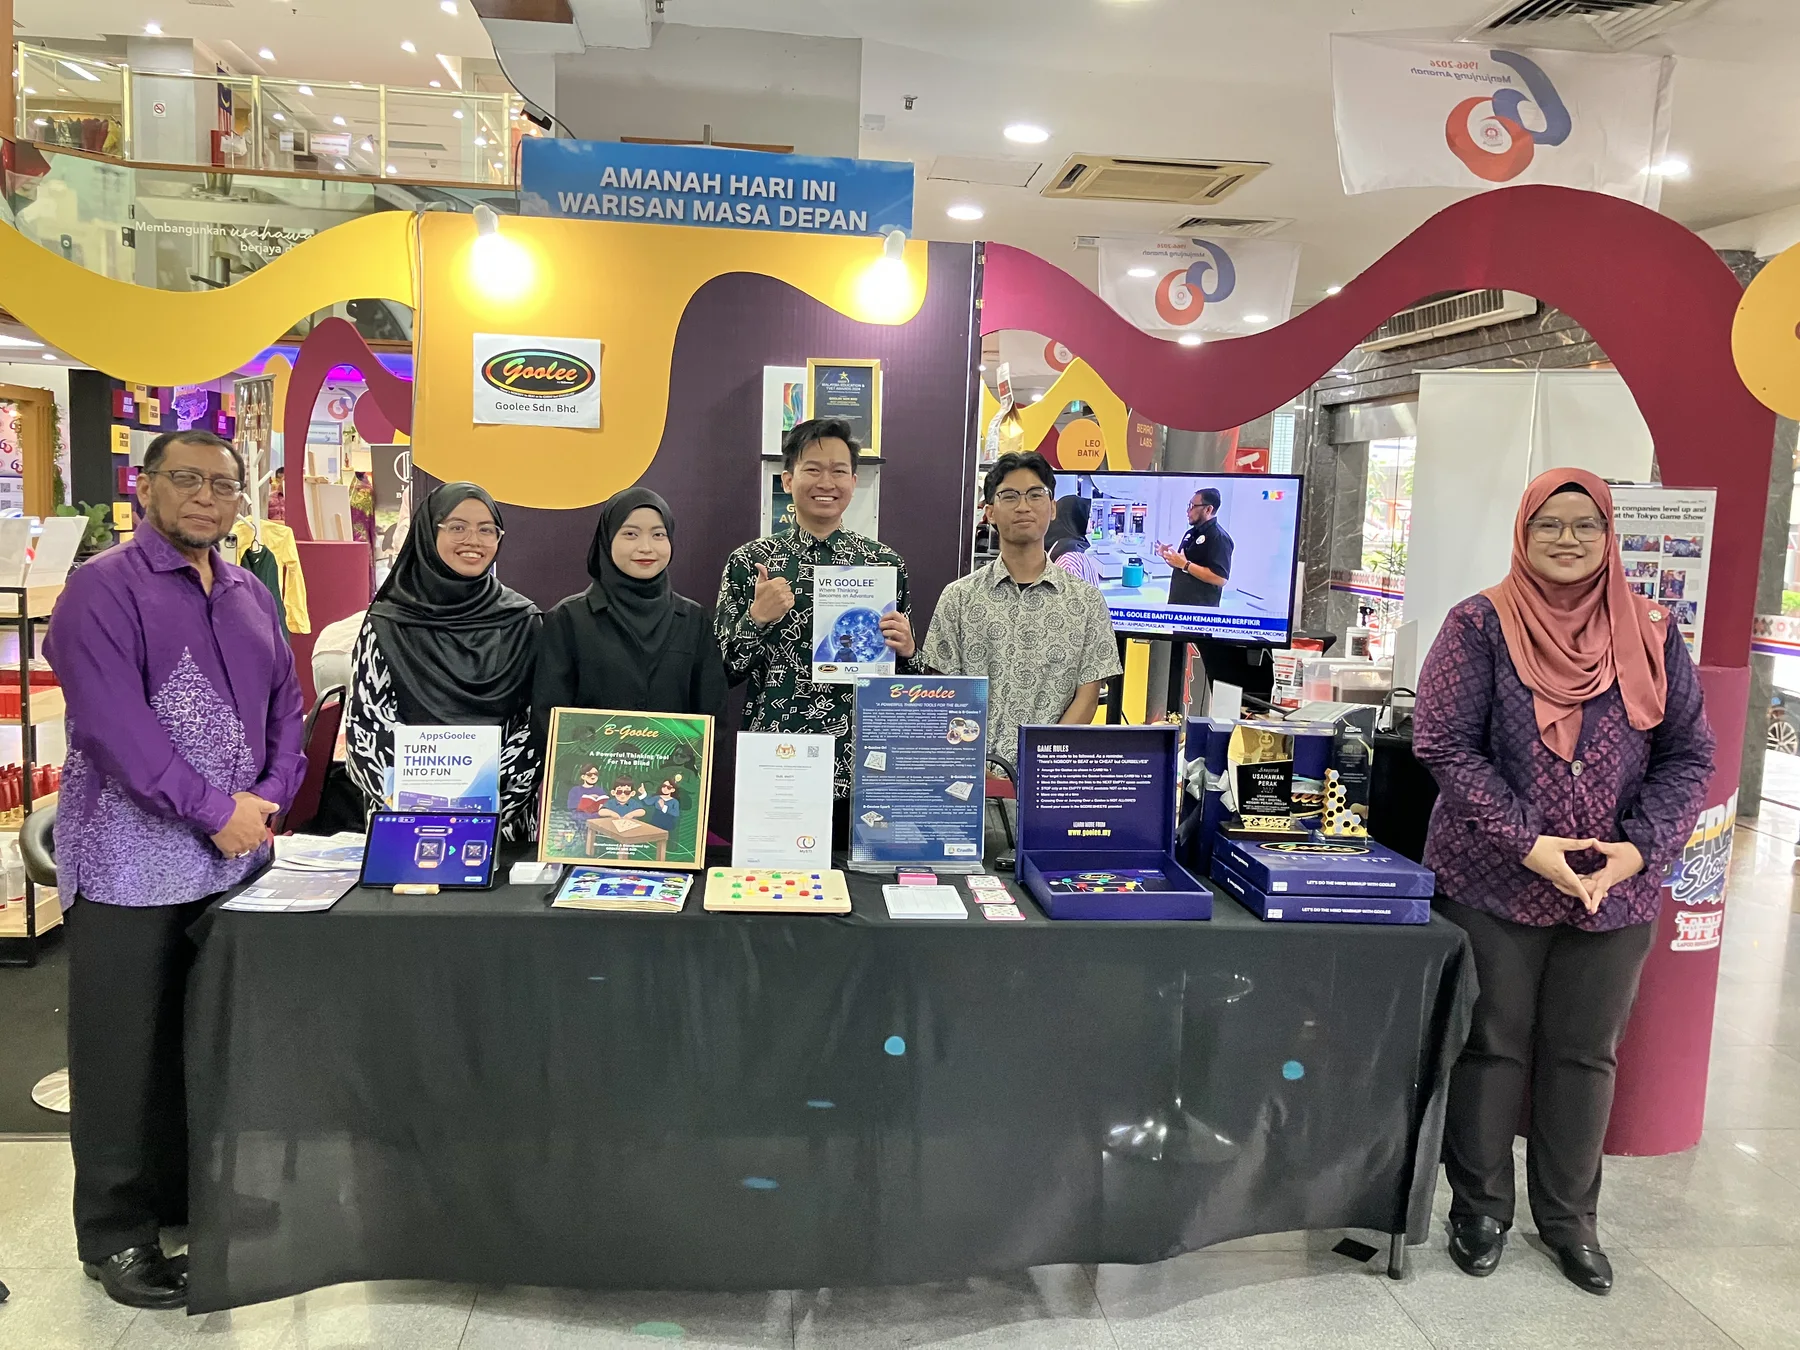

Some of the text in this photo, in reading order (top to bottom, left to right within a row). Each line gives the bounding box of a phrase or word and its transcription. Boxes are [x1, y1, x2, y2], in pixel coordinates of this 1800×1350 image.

[600, 166, 835, 202] AMANAH HARI INI
[558, 191, 867, 231] WARISAN MASA DEPAN
[135, 221, 226, 236] Membangunkan
[240, 241, 281, 256] berjaya
[502, 357, 578, 385] Goolee
[495, 402, 579, 414] Goolee Sdn. Bhd.
[1140, 437, 1153, 448] LABS
[818, 578, 875, 587] VR GOOLEE
[1126, 611, 1151, 619] GOOLEE
[1152, 612, 1174, 620] BANTU
[1192, 615, 1232, 624] KEMAHIRAN
[1232, 618, 1261, 627] BERFIKIR
[890, 684, 956, 702] B-Goolee
[418, 732, 476, 741] AppsGoolee
[604, 724, 659, 740] B-Goolee
[404, 744, 437, 754] TURN
[404, 756, 473, 766] THINKING
[626, 752, 654, 760] Thinking
[403, 768, 451, 776] INTO FUN
